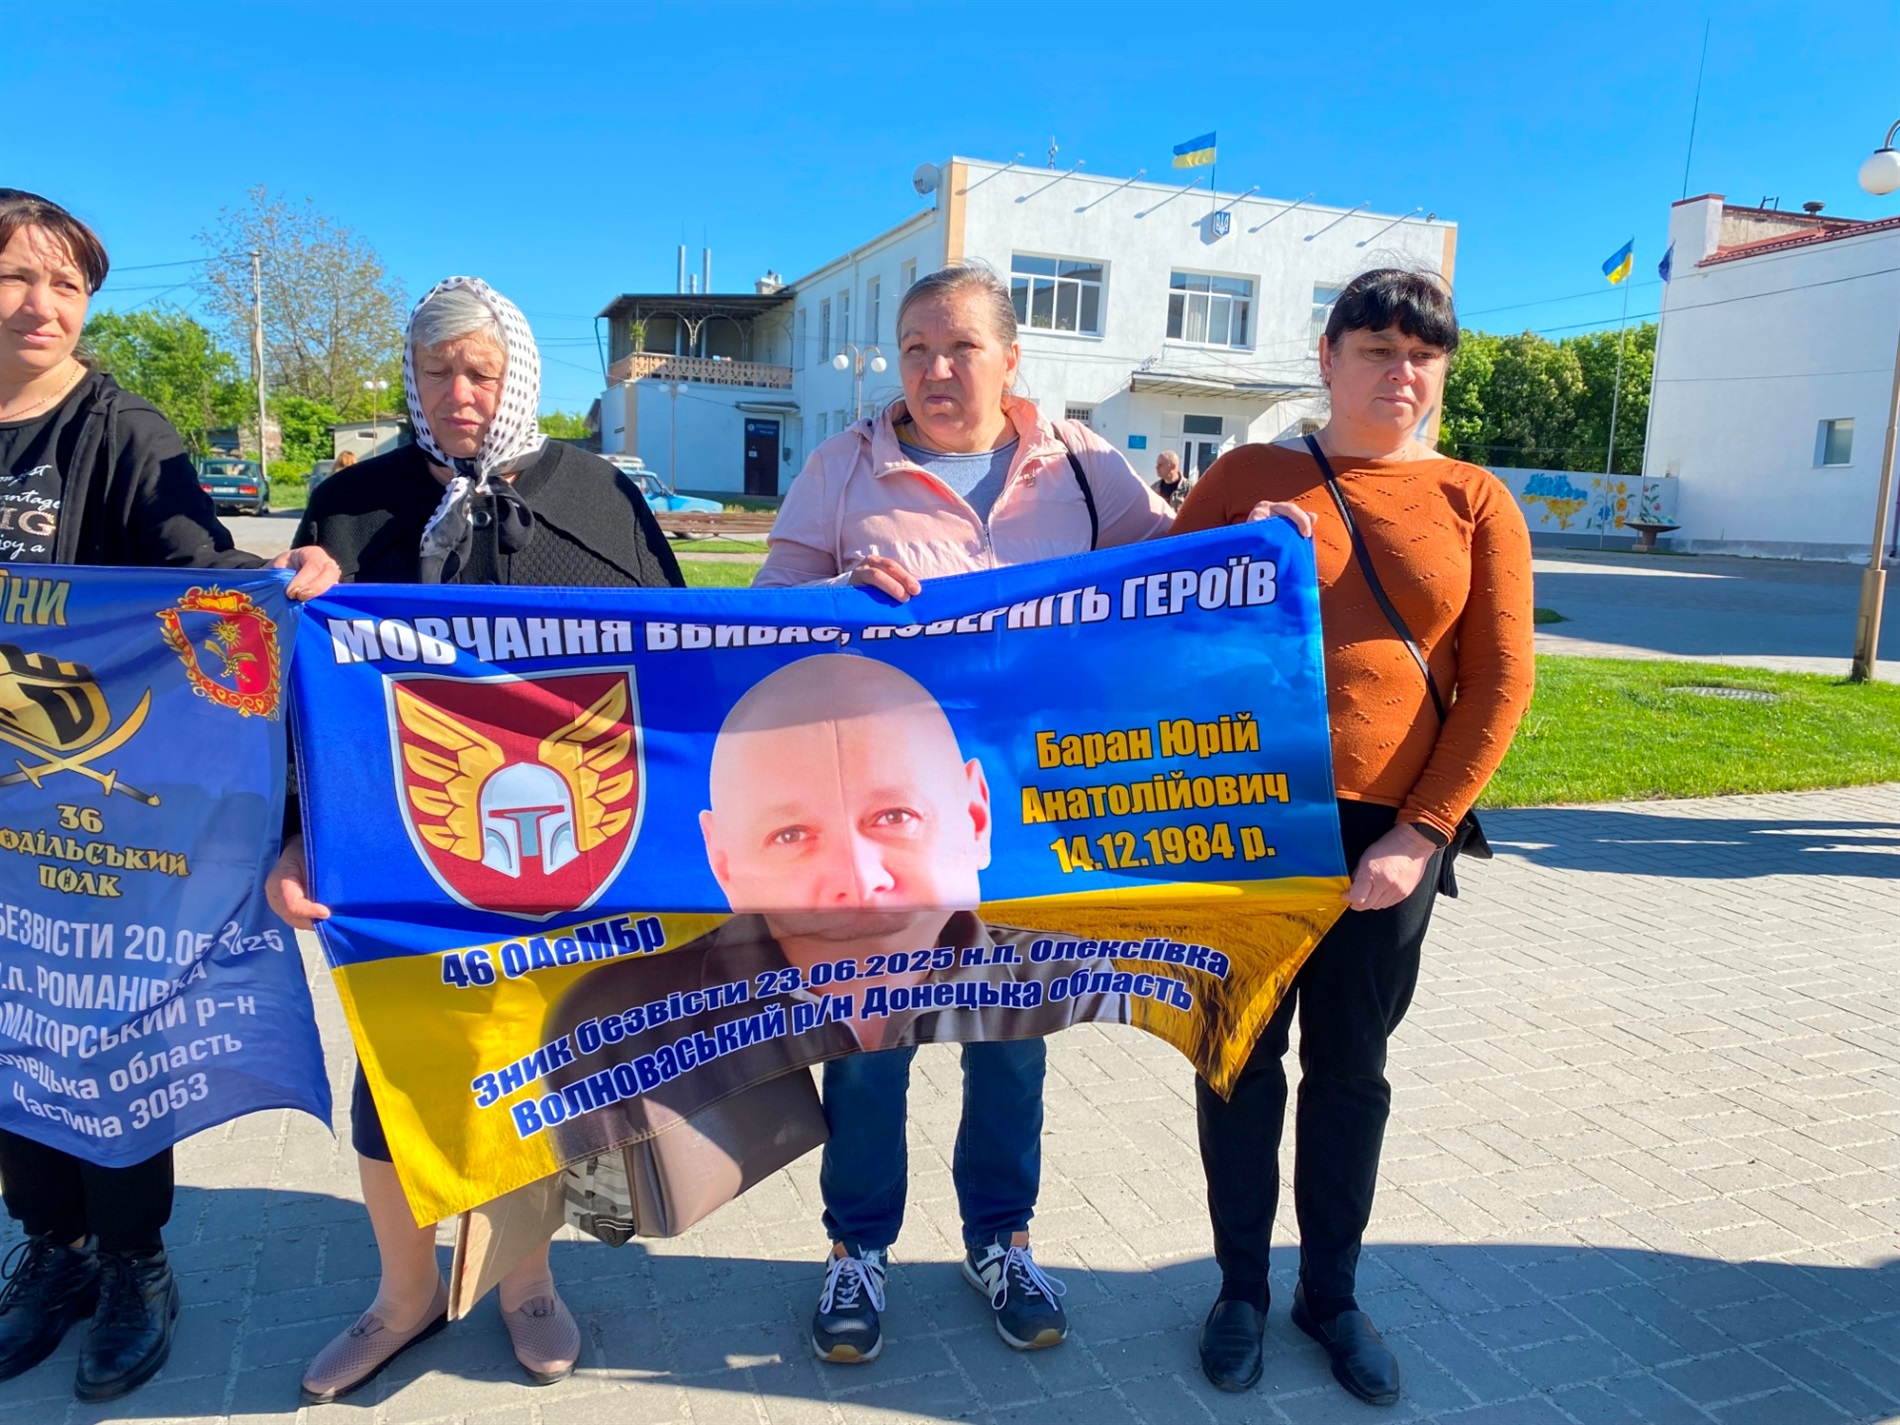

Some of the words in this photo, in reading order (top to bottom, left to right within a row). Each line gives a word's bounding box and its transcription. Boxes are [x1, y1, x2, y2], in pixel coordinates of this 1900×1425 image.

[0, 568, 71, 627] НИ
[327, 616, 634, 666] МОВЧАННЯ
[1121, 555, 1278, 620] ГЕРОЇВ
[1036, 728, 1153, 769] Баран
[1159, 711, 1260, 758] Юрій
[57, 803, 104, 833] 36
[1021, 769, 1290, 825] Анатолійович
[1050, 822, 1236, 874] 14.12.1984
[1240, 825, 1277, 861] р.
[38, 864, 123, 898] ПОЛК
[441, 949, 495, 988] 46
[500, 915, 667, 979] ОАеМБр
[37, 960, 207, 1013] РОМАНІВКА
[0, 995, 187, 1060] МАТОРСЬКИЙ
[196, 995, 256, 1027] р-н
[471, 1034, 577, 1109] Зник
[575, 980, 749, 1055] безвісти
[755, 946, 955, 998] 23.06.2025
[959, 940, 1021, 967] н.п.
[1029, 937, 1230, 979] Олексіївка
[109, 1033, 243, 1092] область
[509, 1004, 786, 1139] Волноваський
[792, 993, 854, 1036] р/н
[860, 980, 1043, 1019] Донецька
[1048, 968, 1194, 1012] область
[13, 1081, 124, 1139] Частина
[129, 1072, 209, 1130] 3053
